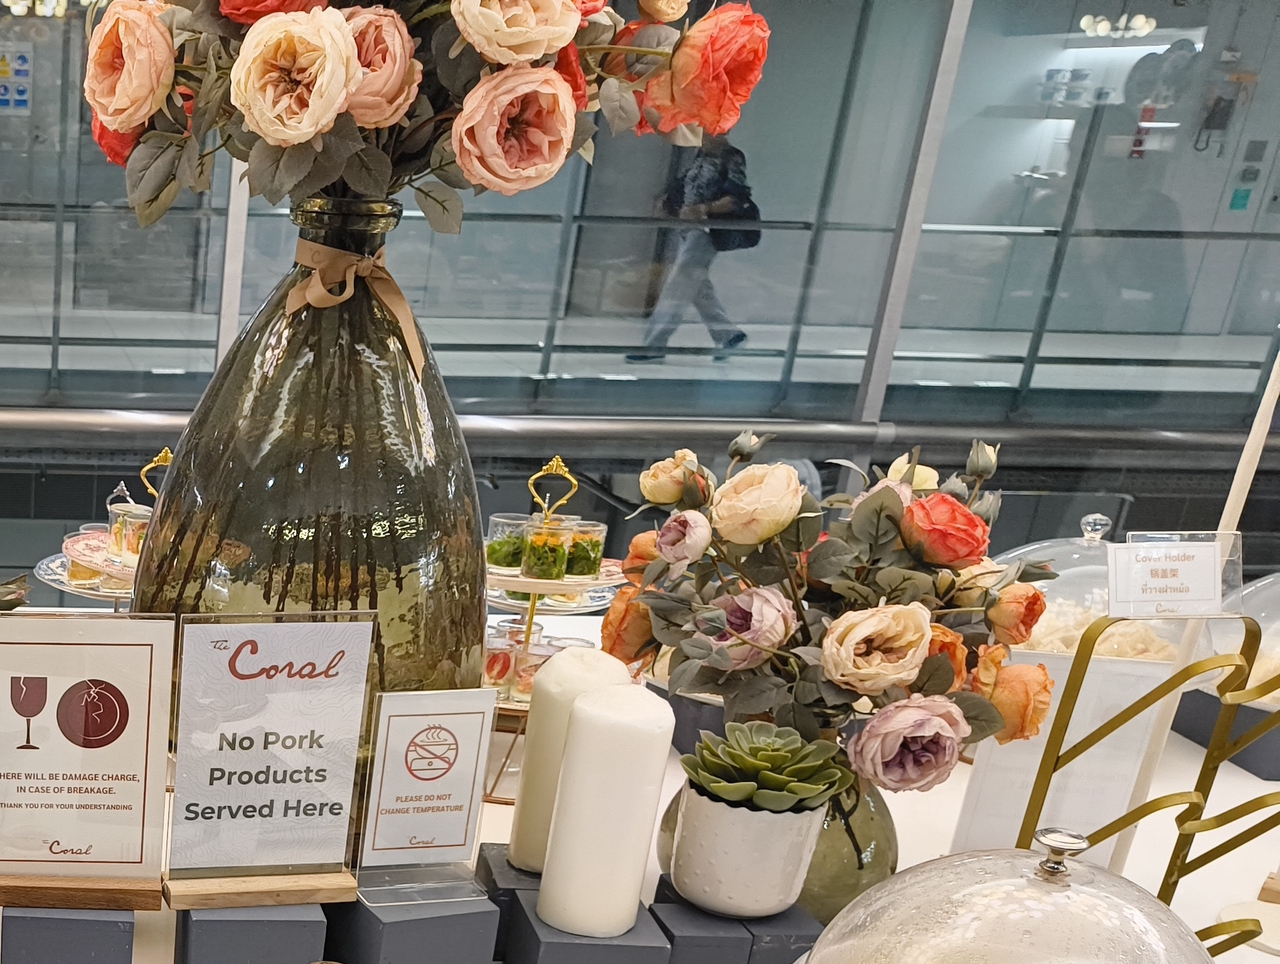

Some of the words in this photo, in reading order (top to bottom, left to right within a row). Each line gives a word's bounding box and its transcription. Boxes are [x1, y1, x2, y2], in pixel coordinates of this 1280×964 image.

[1135, 553, 1162, 562] Cover
[1164, 553, 1196, 562] Holder
[210, 640, 230, 650] The
[228, 640, 346, 680] Coral
[218, 732, 255, 751] No
[263, 730, 325, 750] Pork
[62, 773, 100, 781] DAMAGE
[101, 774, 140, 783] CHARGE,
[209, 766, 328, 786] Products
[28, 786, 51, 794] CASE
[67, 787, 116, 795] BREAKAGE.
[395, 795, 423, 803] PLEASE
[436, 793, 452, 801] NOT
[184, 799, 275, 821] Served
[283, 800, 344, 818] Here
[380, 807, 410, 815] CHANGE
[412, 805, 464, 813] TEMPERATURE
[409, 836, 435, 845] Coral
[48, 840, 93, 855] Coral
